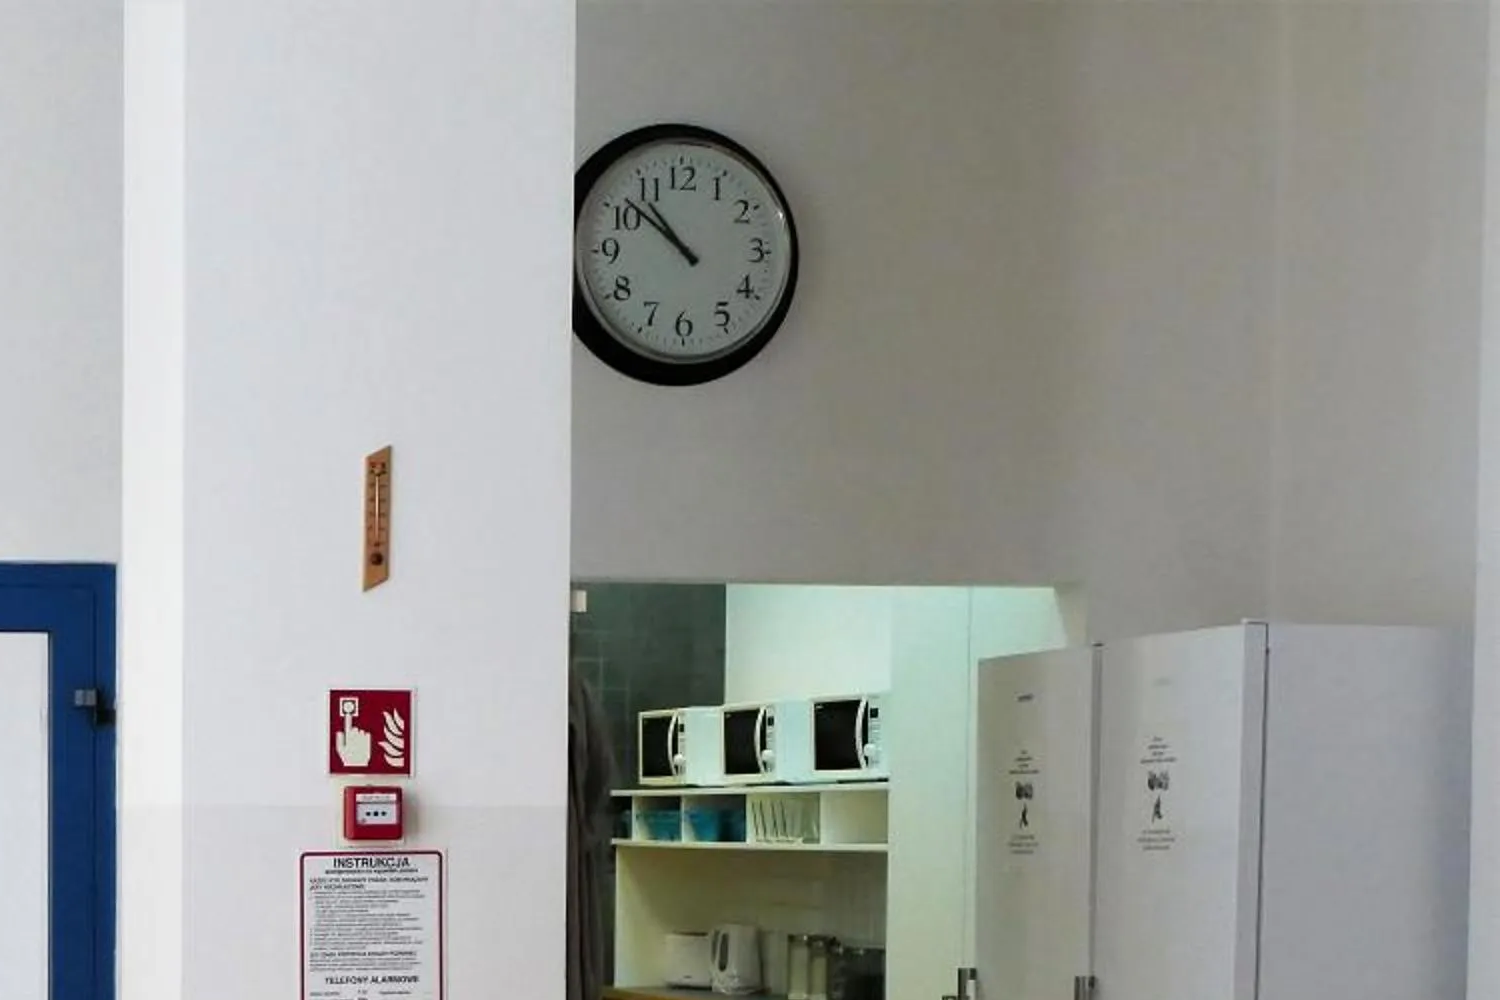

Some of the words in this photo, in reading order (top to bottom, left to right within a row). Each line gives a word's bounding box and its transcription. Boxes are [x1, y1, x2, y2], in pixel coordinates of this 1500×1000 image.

[640, 177, 660, 201] 11
[669, 167, 697, 191] 12
[712, 176, 721, 201] 1
[612, 205, 641, 231] 10
[734, 200, 749, 223] 2
[601, 238, 621, 264] 9
[749, 238, 765, 262] 3
[613, 276, 631, 301] 8
[736, 275, 754, 300] 4
[643, 302, 660, 327] 7
[675, 311, 693, 337] 6
[713, 302, 731, 327] 5
[333, 857, 411, 869] INSTRUKCJA
[325, 976, 369, 985] TELEFONY
[370, 975, 420, 984] ALARMOWE
